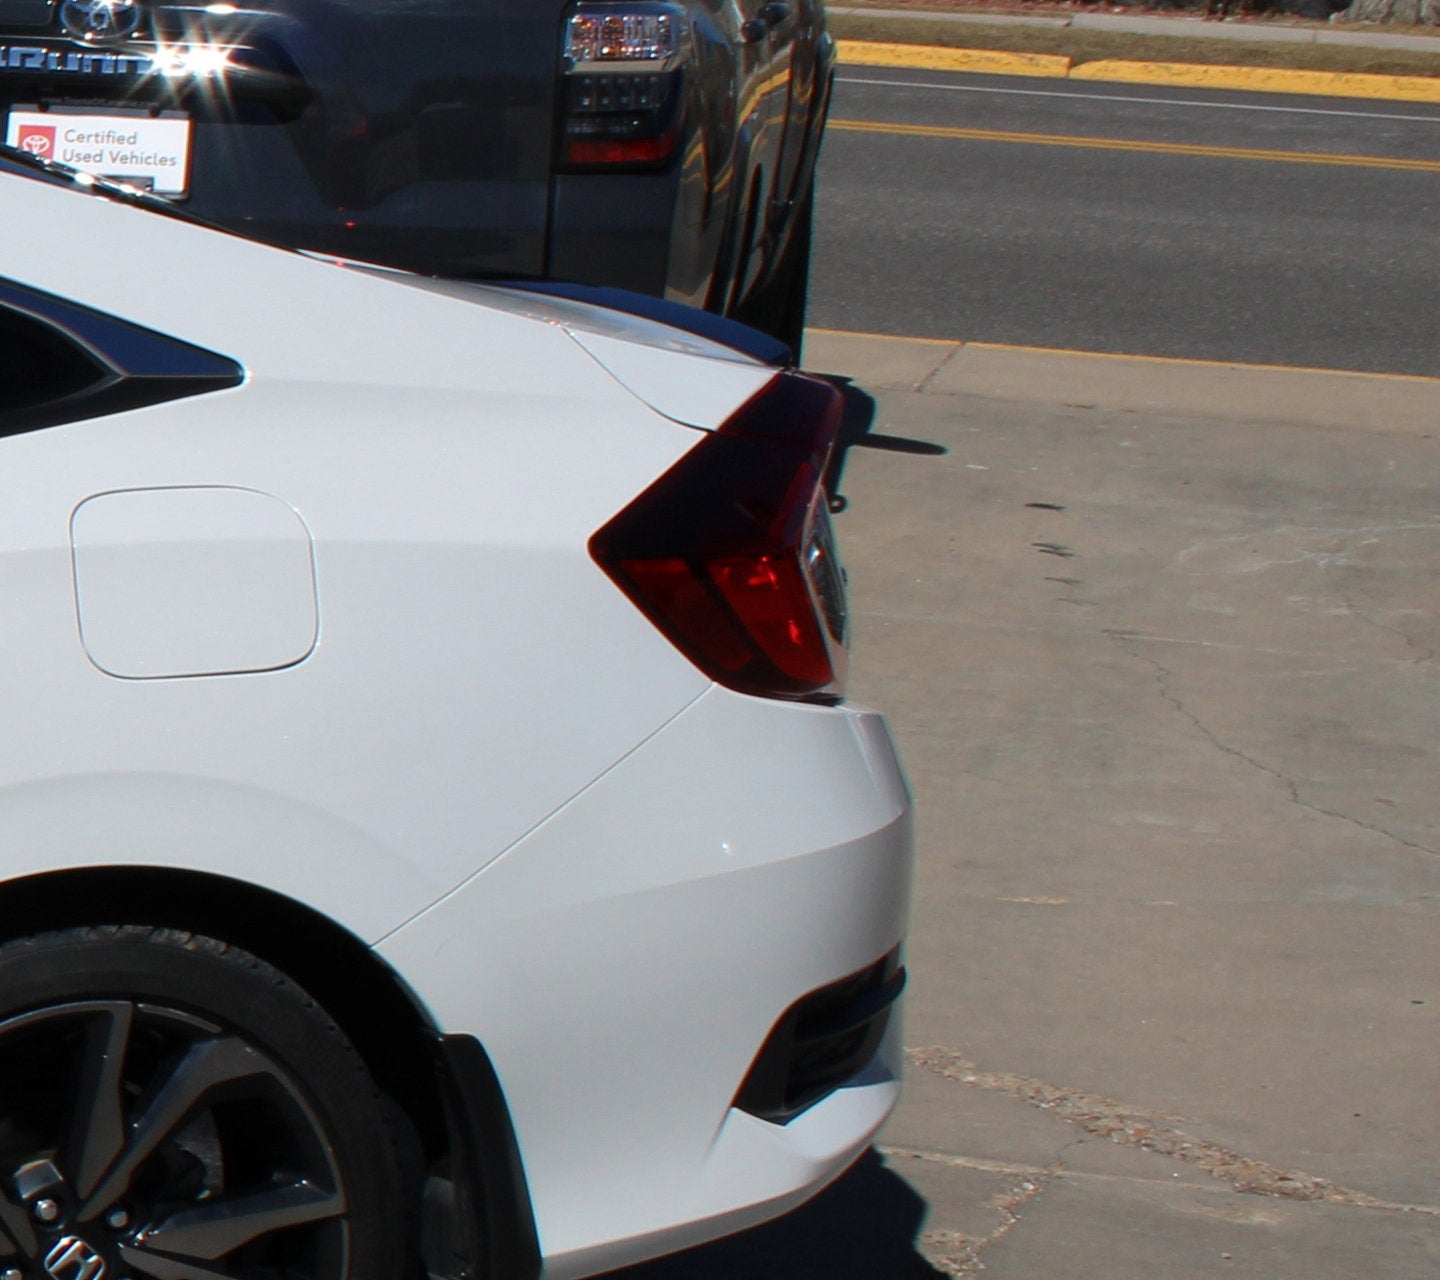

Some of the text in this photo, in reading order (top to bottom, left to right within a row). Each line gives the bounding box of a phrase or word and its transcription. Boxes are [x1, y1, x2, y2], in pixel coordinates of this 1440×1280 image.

[64, 128, 137, 146] Certified
[62, 149, 177, 167] Used Vehicles
